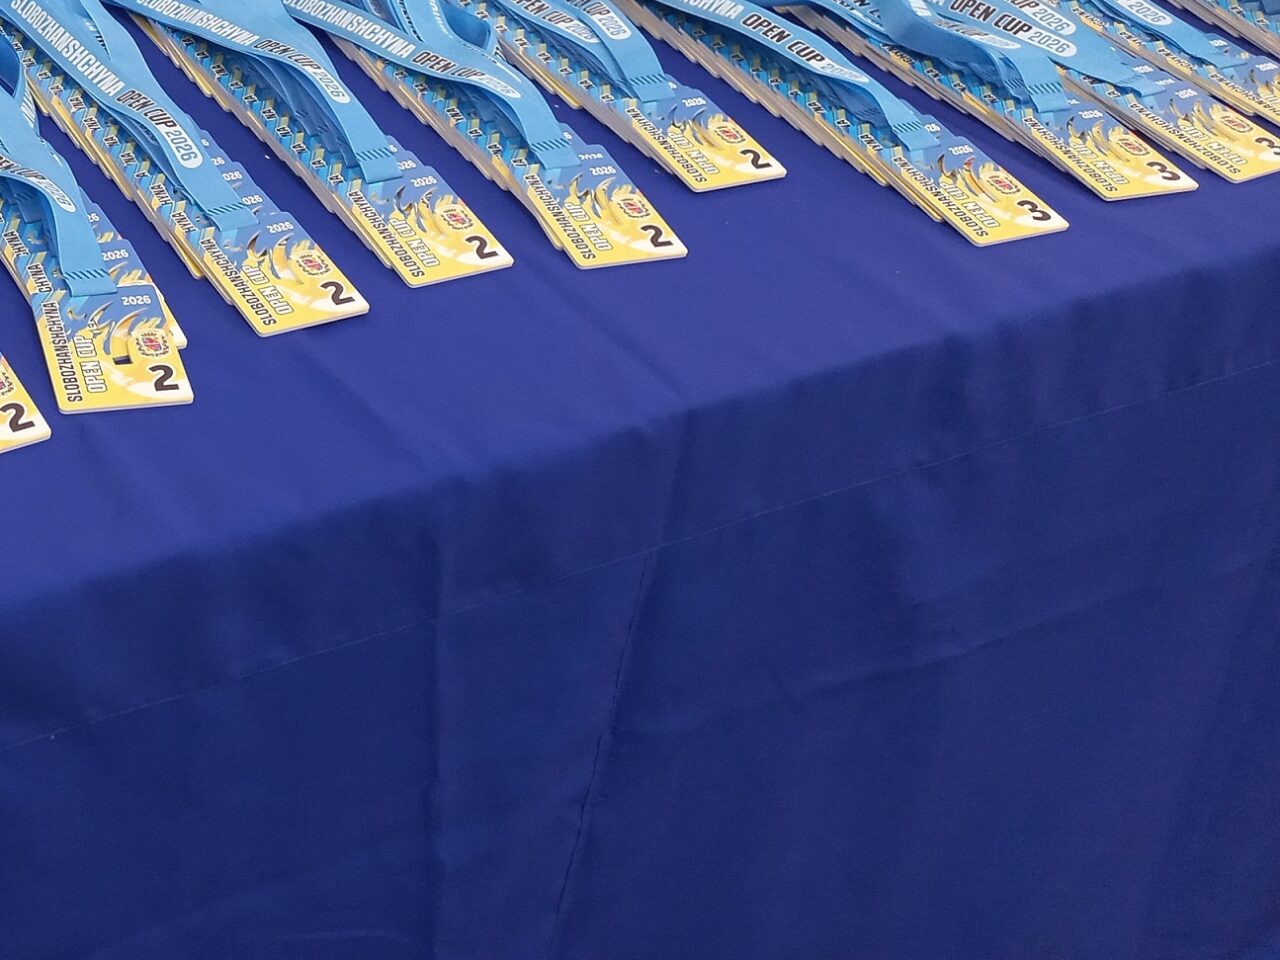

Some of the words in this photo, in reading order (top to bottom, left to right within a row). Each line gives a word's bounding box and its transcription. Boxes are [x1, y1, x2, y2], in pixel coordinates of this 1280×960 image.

[542, 10, 574, 25] CUP
[582, 1, 611, 17] CUP
[1032, 6, 1070, 34] 2026
[1128, 0, 1163, 24] 2026
[740, 12, 792, 43] OPEN
[786, 38, 826, 69] CUP
[993, 13, 1033, 37] CUP
[1027, 31, 1070, 54] 2026
[252, 38, 294, 56] OPEN
[287, 49, 322, 72] CUP
[312, 68, 346, 98] 2026
[412, 50, 459, 76] OPEN
[450, 64, 486, 81] CUP
[115, 87, 157, 116] OPEN
[143, 107, 178, 135] CUP
[165, 129, 198, 162] 2026
[1180, 123, 1210, 141] CUP
[625, 108, 708, 183] SLOBOZHANSHCHYNA
[667, 131, 694, 150] CUP
[1069, 142, 1099, 159] CUP
[1255, 137, 1280, 155] 3
[686, 150, 721, 175] OPEN
[739, 149, 773, 170] 2
[1207, 141, 1248, 165] OPEN
[222, 170, 242, 181] 026
[411, 176, 438, 187] 2026
[590, 166, 616, 176] 2026
[1092, 159, 1129, 185] OPEN
[1146, 161, 1180, 181] 3
[242, 194, 263, 205] 026
[892, 155, 989, 238] SLOBOZHANSHCHYNA
[939, 181, 969, 201] CUP
[524, 174, 596, 260] SLOBOZHANSHCHYNA
[564, 202, 591, 222] CUP
[961, 201, 1001, 229] OPEN
[1017, 200, 1052, 222] 3
[266, 222, 294, 233] 2026
[348, 190, 425, 278] SLOBOZHANSHCHYNA
[389, 218, 416, 238] CUP
[580, 223, 613, 251] OPEN
[641, 224, 674, 248] 2
[102, 249, 129, 261] 2026
[406, 238, 440, 268] OPEN
[465, 235, 499, 260] 2
[200, 238, 277, 326] SLOBOZHANSHCHYNA
[242, 264, 270, 285] CUP
[122, 295, 151, 306] 2026
[258, 286, 294, 316] OPEN
[321, 281, 356, 306] 2
[42, 302, 82, 402] SLOBOZHANSHCHYNA
[74, 335, 98, 358] CUP
[79, 361, 108, 393] OPEN
[149, 364, 179, 392] 2
[0, 403, 36, 433] 2
